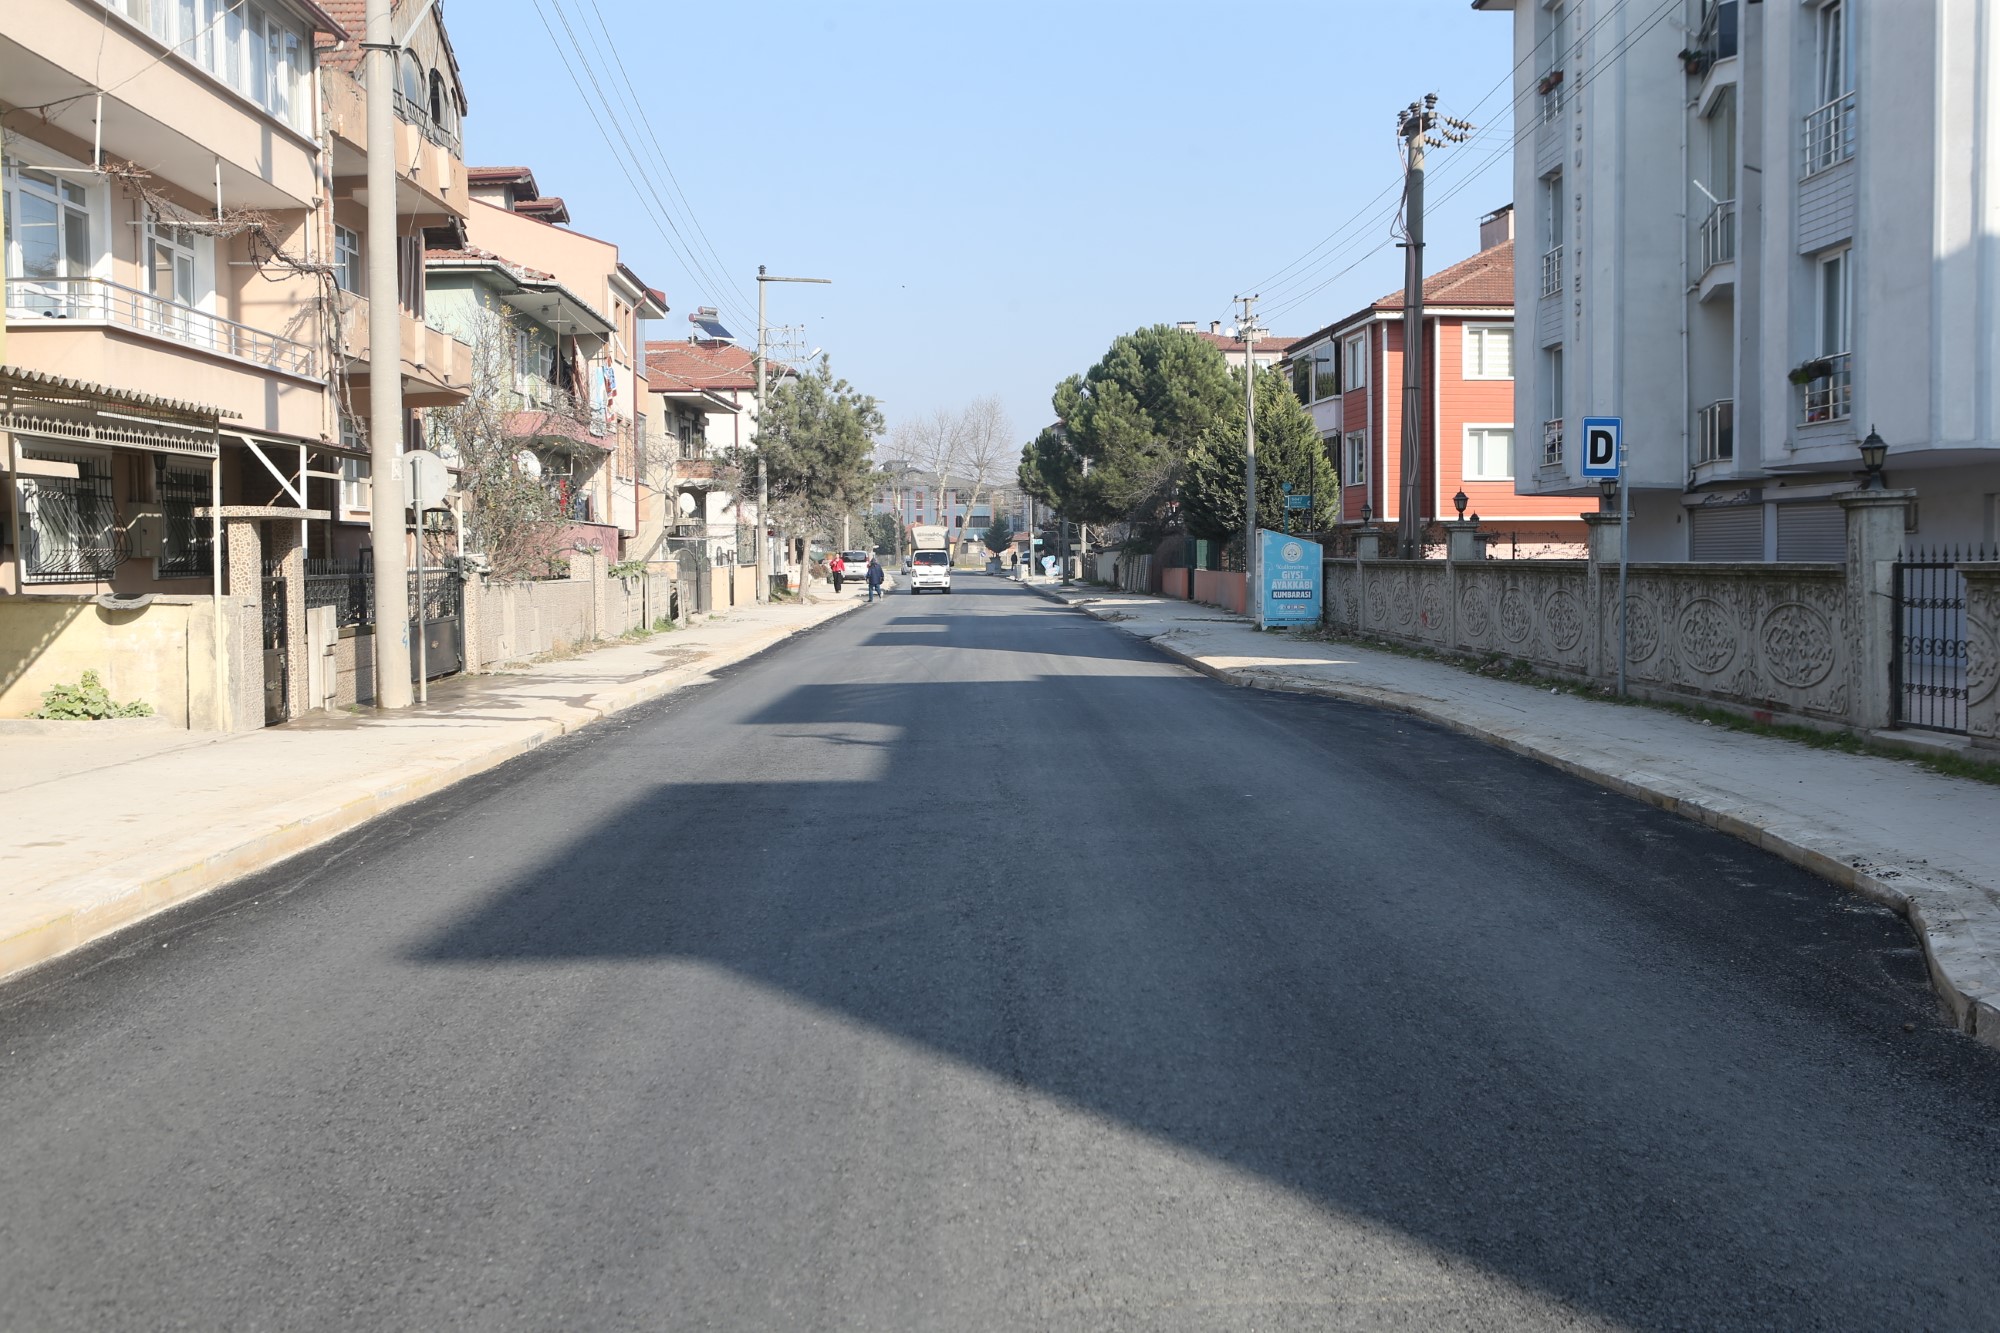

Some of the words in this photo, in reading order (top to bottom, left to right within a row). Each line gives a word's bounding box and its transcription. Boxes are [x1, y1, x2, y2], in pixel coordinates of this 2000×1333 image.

[1590, 430, 1613, 464] D
[1272, 580, 1312, 589] AYAKKABI
[1273, 591, 1311, 599] KUMBARASI
